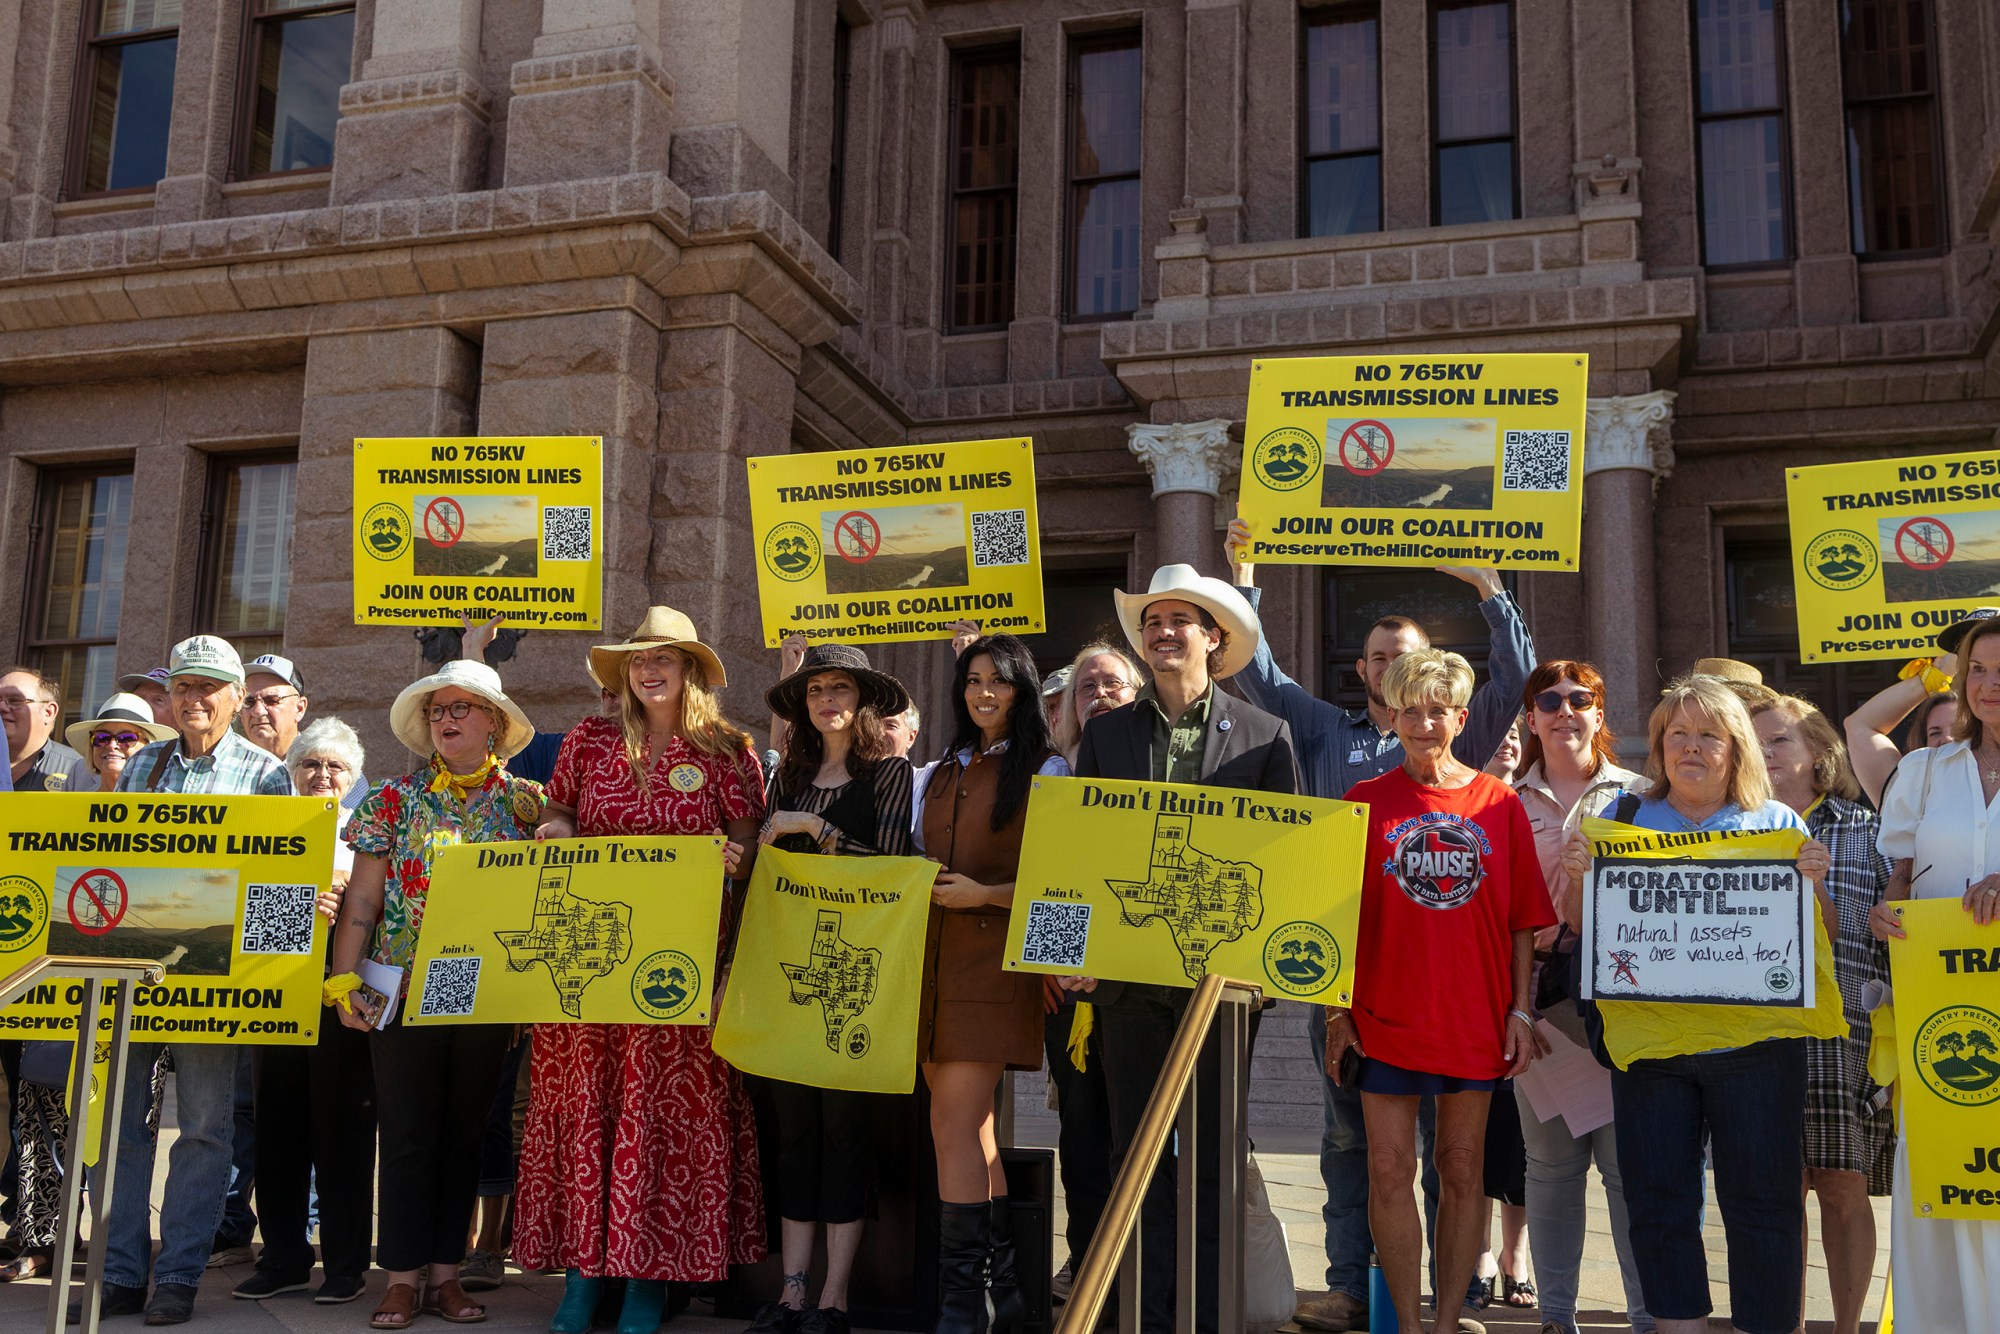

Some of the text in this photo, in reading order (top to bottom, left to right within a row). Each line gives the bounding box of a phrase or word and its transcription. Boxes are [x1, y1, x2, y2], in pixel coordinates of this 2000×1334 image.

[1355, 363, 1483, 382] NO 765KV
[1281, 388, 1559, 407] TRANSMISSION LINES
[431, 446, 525, 461] NO 765KV
[836, 452, 945, 476] NO 765KV
[378, 468, 582, 484] TRANSMISSION LINES
[1898, 459, 2000, 482] NO 765
[777, 471, 1012, 503] TRANSMISSION LINES
[1272, 517, 1543, 539] JOIN OUR COALITION
[1254, 541, 1560, 563] PreserveTheHillCountry.com
[380, 585, 575, 603] JOIN OUR COALITION
[368, 606, 588, 625] PreserveTheHillCountry.com
[790, 592, 1013, 621] JOIN OUR COALITION
[1837, 613, 1902, 632] JOIN
[1911, 609, 1968, 628] OUR
[1821, 634, 1940, 653] PreserveT
[674, 767, 694, 787] 765
[686, 768, 699, 779] NO
[89, 803, 228, 825] NO 765KV
[1081, 785, 1312, 826] Don't Ruin Texas
[8, 832, 307, 856] TRANSMISSION LINES
[1385, 812, 1492, 855] SAVE RURAL TEXAS
[1593, 836, 1654, 857] Don't
[1658, 829, 1712, 849] Ruin
[476, 842, 677, 869] Don't Ruin Texas
[1406, 851, 1475, 878] PAUSE
[775, 876, 902, 904] Don't Ruin Texas
[1412, 883, 1469, 900] AI DATA CENTERS
[1605, 871, 1794, 892] MORATORIUM
[14, 880, 44, 920] PRESERVATION
[1042, 887, 1083, 900] Join Us
[1628, 890, 1770, 916] UNTIL...
[1617, 919, 1753, 944] natural assets
[440, 944, 475, 955] Join Us
[1272, 925, 1303, 944] COUNTRY
[1305, 925, 1336, 968] PRESERVATION
[1649, 939, 1793, 966] are valued, too!
[640, 954, 667, 974] COUNTRY
[669, 953, 696, 990] PRESERVATION
[1274, 974, 1326, 992] COALITION
[11, 985, 283, 1008] IN OR COALITION
[641, 1001, 687, 1015] COALITION
[1919, 1044, 1927, 1063] HILL
[1923, 1011, 1959, 1041] COUNTRY
[1934, 1081, 2000, 1100] COALITIO
